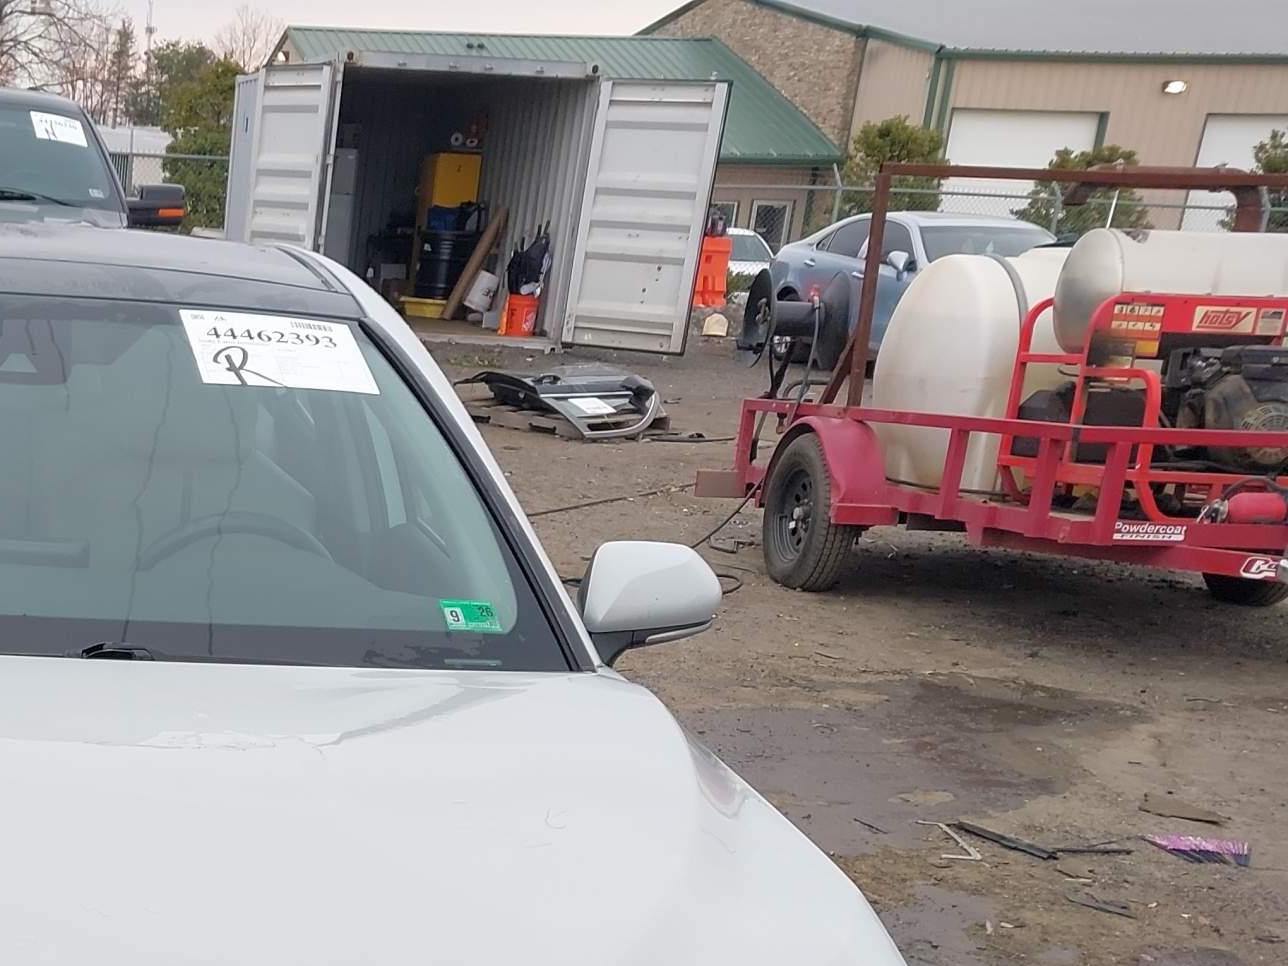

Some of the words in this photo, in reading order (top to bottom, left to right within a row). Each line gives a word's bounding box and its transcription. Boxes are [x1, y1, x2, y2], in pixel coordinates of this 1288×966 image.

[206, 326, 338, 349] 44462393
[1114, 521, 1188, 536] Powdercoat
[449, 609, 460, 622] 9
